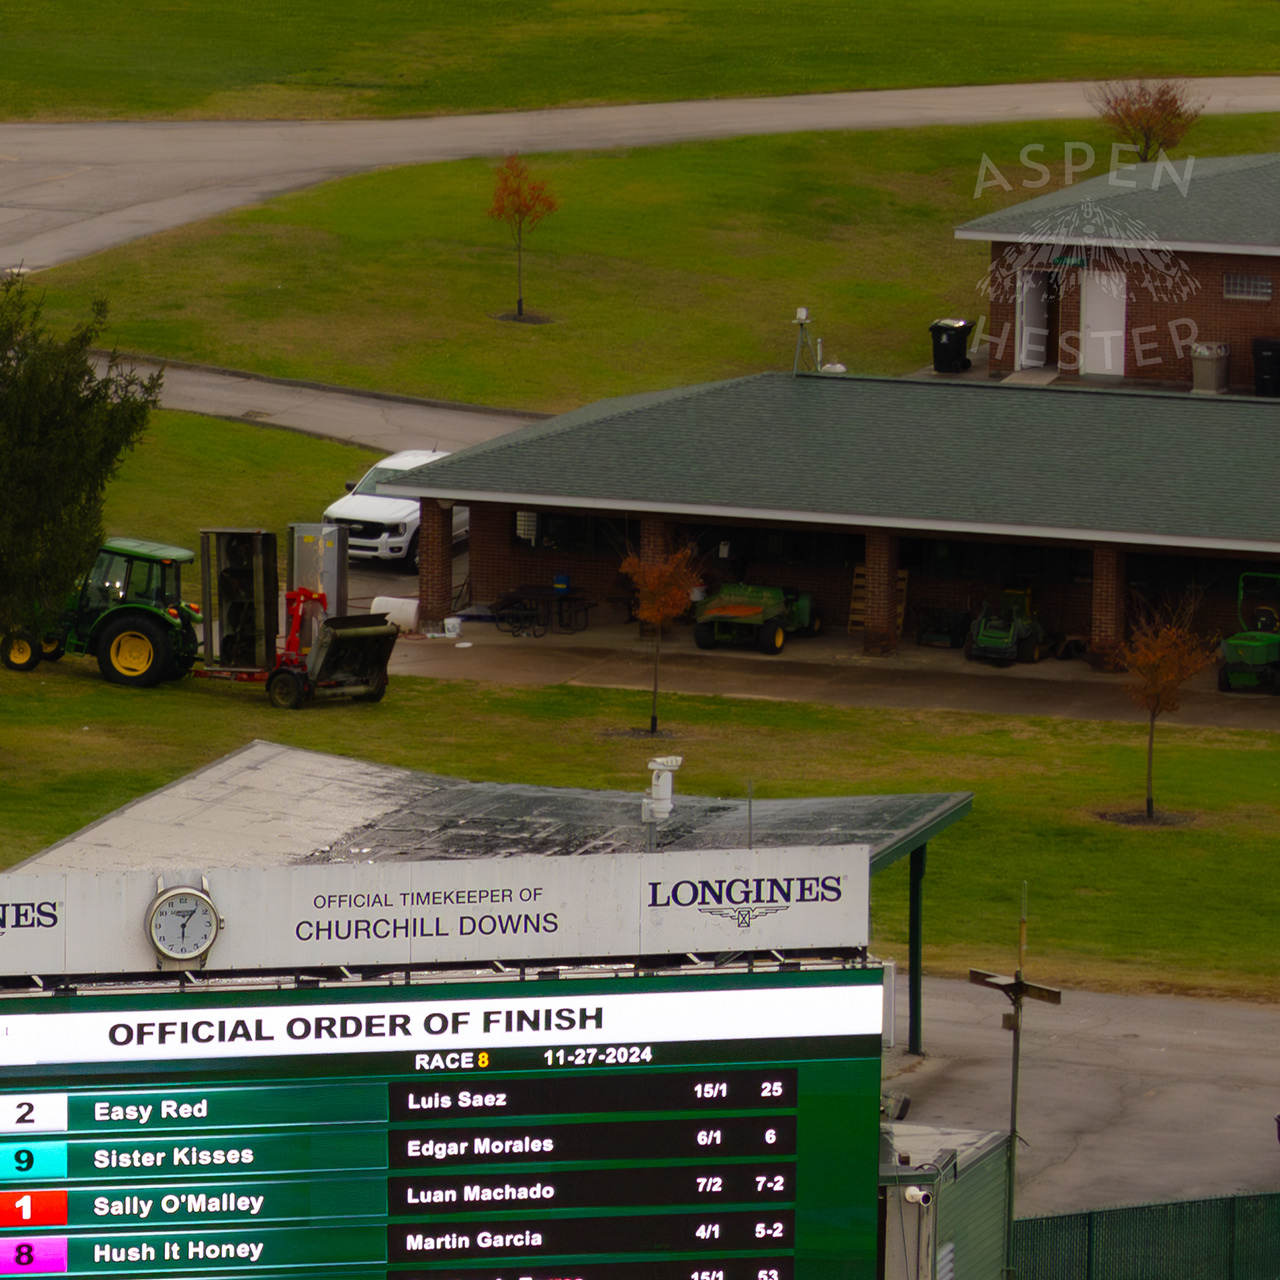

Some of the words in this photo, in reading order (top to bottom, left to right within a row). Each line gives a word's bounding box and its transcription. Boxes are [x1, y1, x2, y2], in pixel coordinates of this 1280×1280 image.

[313, 893, 393, 909] OFFICIAL
[400, 888, 513, 907] TIMEKEEPER
[519, 888, 543, 902] OF
[648, 876, 842, 907] LONGINES
[295, 917, 449, 941] CHURCHILL
[460, 912, 559, 936] DOWNS
[108, 1018, 274, 1046] OFFICIAL
[286, 1015, 412, 1040] ORDER
[423, 1011, 470, 1035] OF
[483, 1007, 603, 1033] FINISH
[415, 1052, 474, 1070] RACE
[477, 1051, 489, 1068] 8
[544, 1046, 653, 1066] 11-27-2024
[15, 1102, 35, 1125] 2
[94, 1101, 153, 1125] Easy
[161, 1098, 208, 1119] Red
[408, 1092, 452, 1110] Luis
[457, 1091, 507, 1108] Saez
[694, 1082, 727, 1099] 15/1
[760, 1081, 783, 1097] 25
[14, 1149, 34, 1172] 9
[93, 1149, 167, 1169] Sister
[173, 1146, 254, 1166] Kisses
[407, 1139, 469, 1160] Edgar
[474, 1136, 554, 1155] Morales
[697, 1129, 721, 1146] 6/1
[764, 1129, 777, 1144] 6
[15, 1195, 32, 1219] 1
[93, 1195, 154, 1219] Sally
[160, 1192, 264, 1214] O'Malley
[407, 1187, 457, 1204] Luan
[463, 1182, 555, 1202] Machado
[696, 1176, 723, 1193] 7/2
[755, 1175, 785, 1192] 7-2
[15, 1244, 34, 1266] 8
[94, 1242, 156, 1263] Hush
[164, 1241, 180, 1260] It
[188, 1240, 264, 1265] Honey
[406, 1233, 470, 1251] Martin
[476, 1230, 542, 1248] Garcia
[695, 1224, 720, 1240] 4/1
[755, 1222, 784, 1238] 5-2
